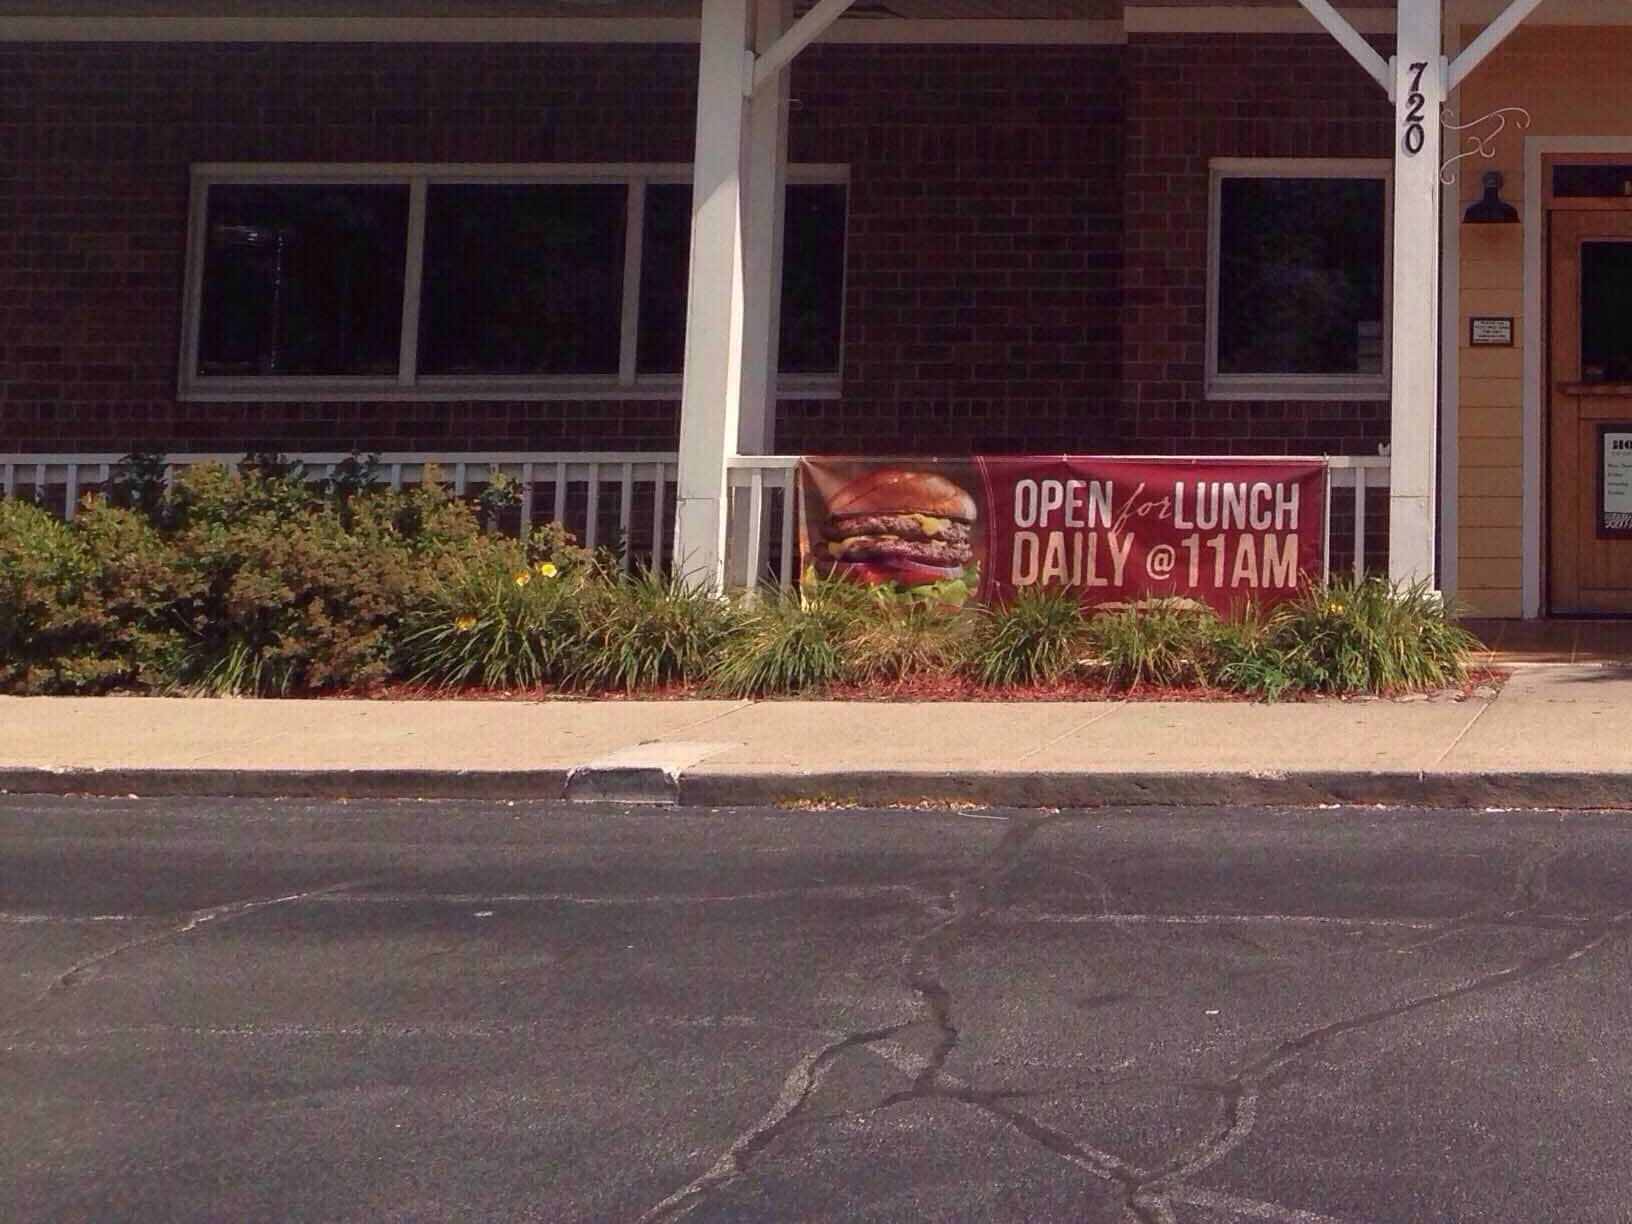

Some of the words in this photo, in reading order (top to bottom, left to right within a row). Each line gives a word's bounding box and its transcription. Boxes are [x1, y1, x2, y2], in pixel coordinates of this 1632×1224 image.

[1405, 61, 1428, 154] 720
[1013, 478, 1114, 530] OPEN
[1110, 482, 1174, 538] for
[1173, 481, 1300, 531] LUNCH
[1012, 530, 1136, 587] DAILY
